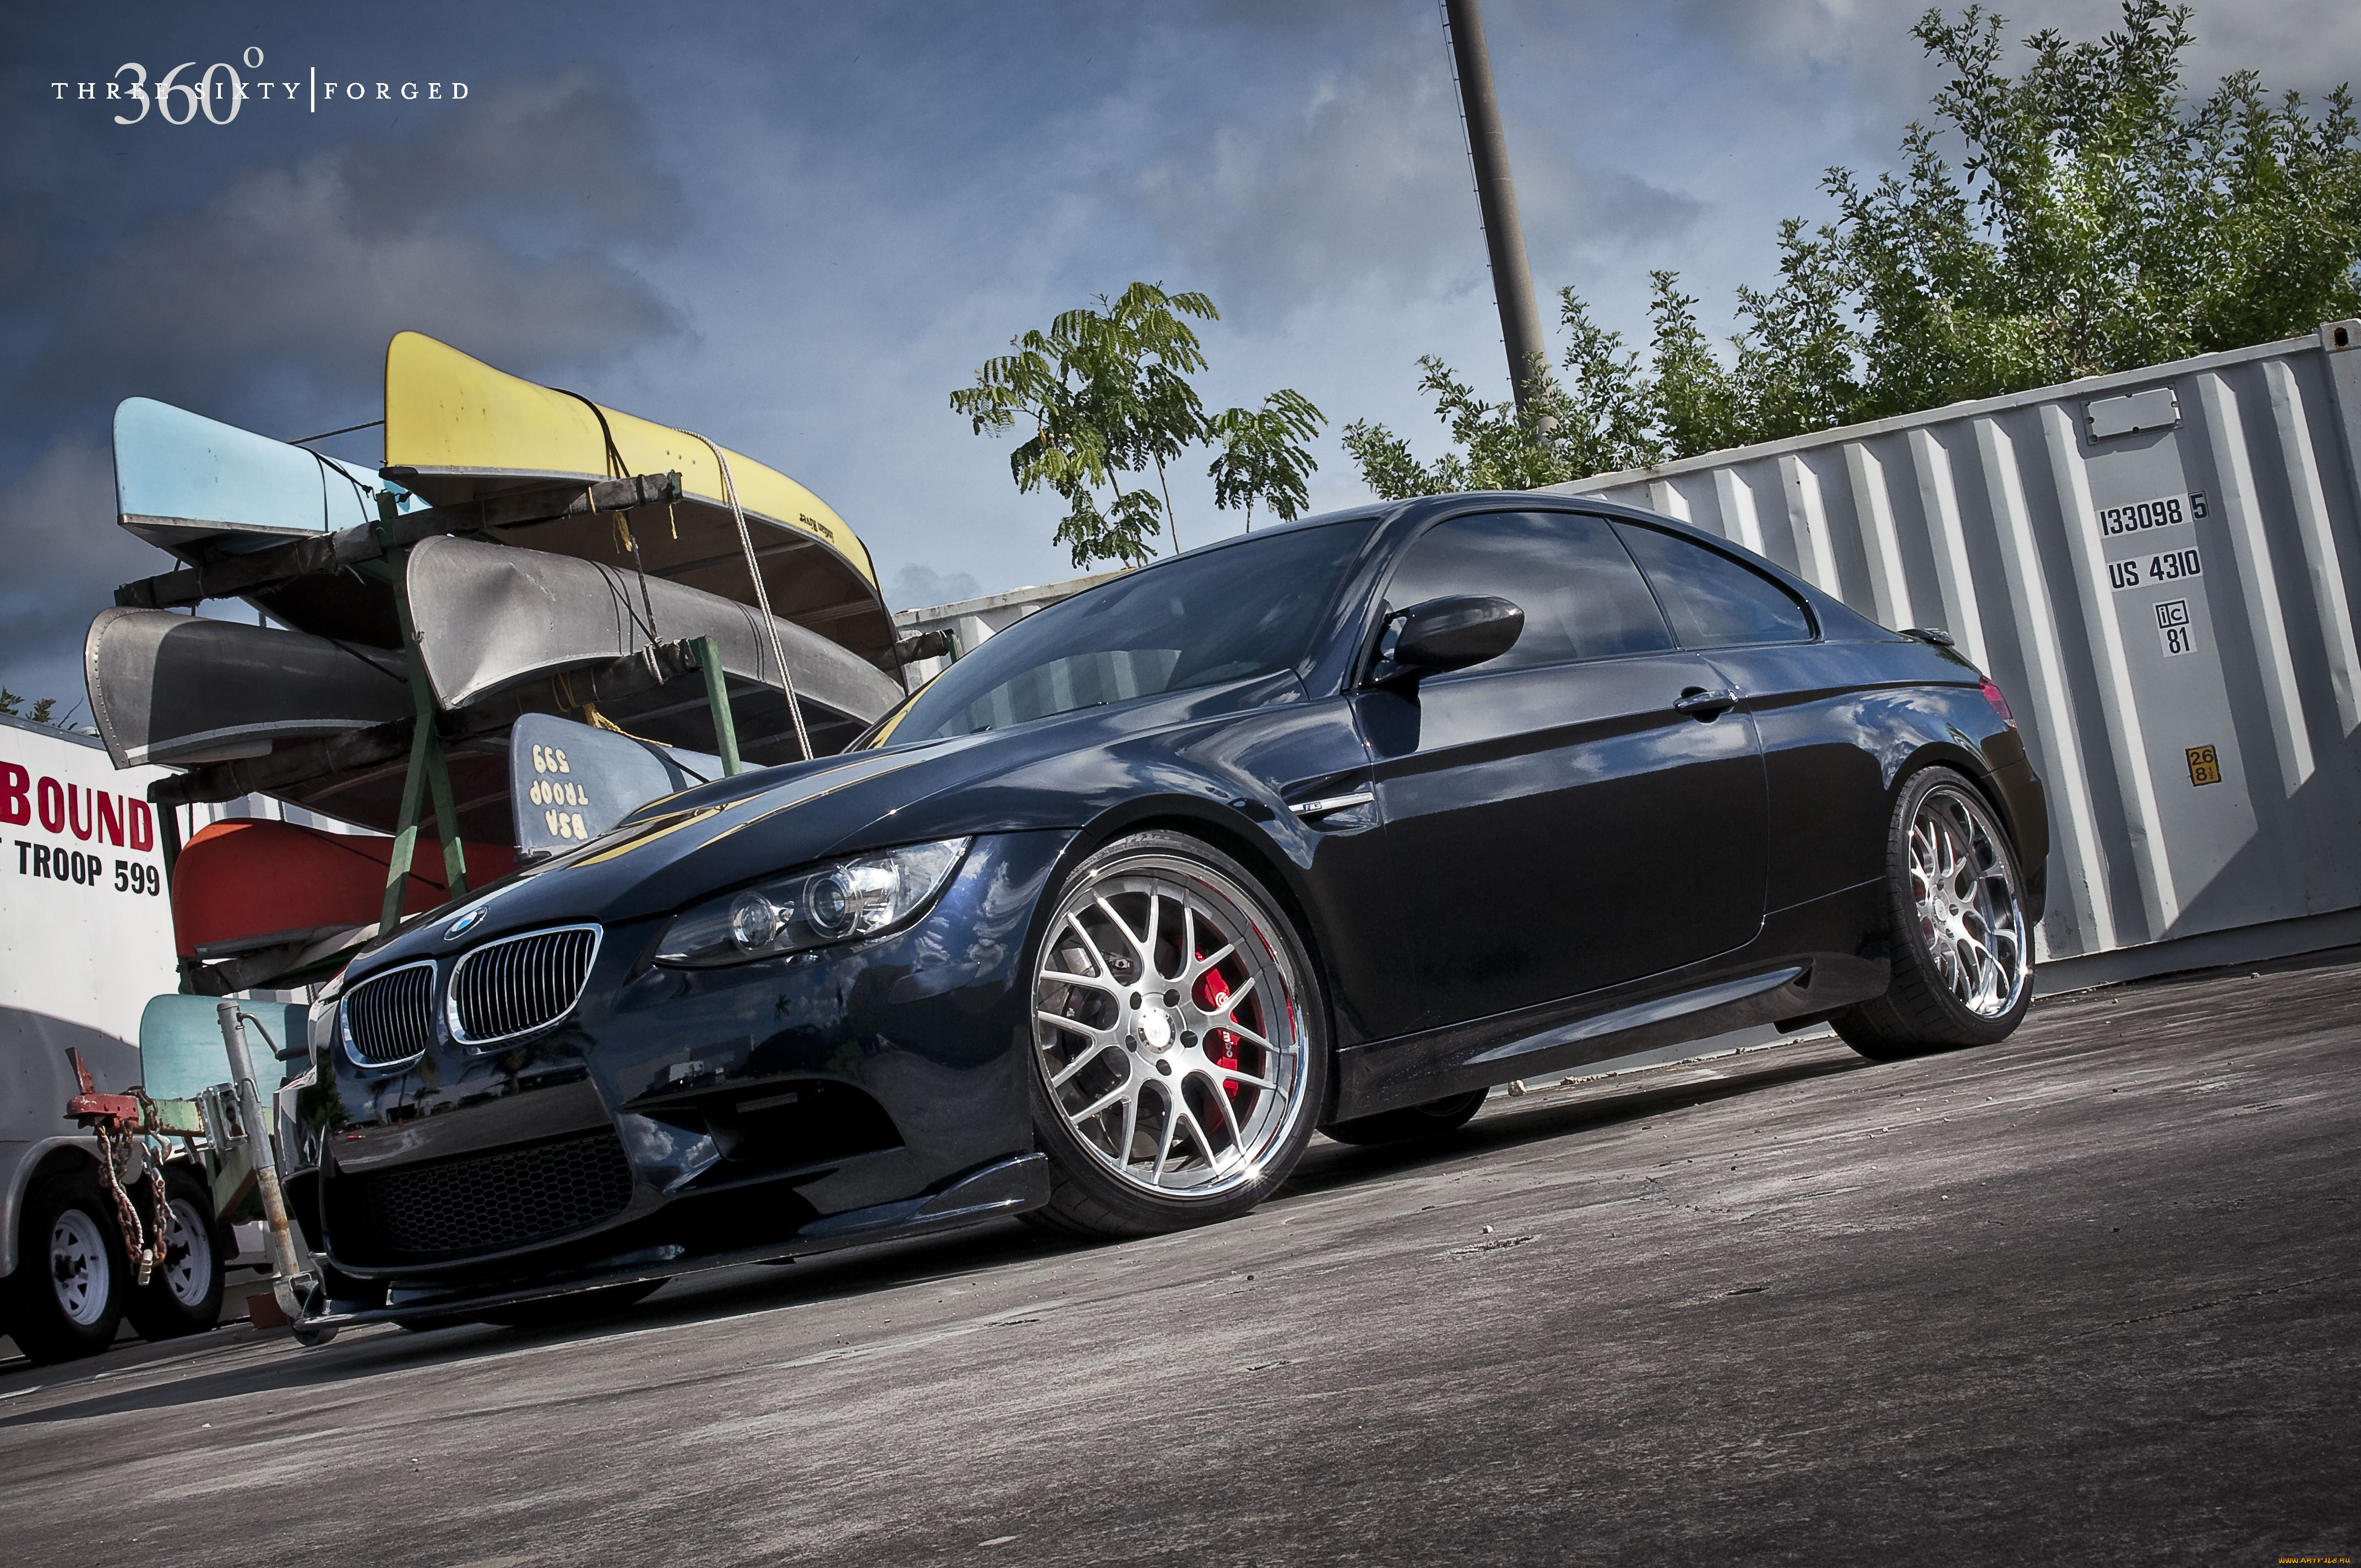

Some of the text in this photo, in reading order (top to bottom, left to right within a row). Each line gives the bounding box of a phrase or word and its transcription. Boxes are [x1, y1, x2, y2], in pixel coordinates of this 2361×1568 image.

[799, 513, 818, 532] River
[2100, 493, 2207, 536] 133098 5
[2109, 549, 2201, 589] US 4310
[2167, 627, 2190, 654] 81
[533, 744, 570, 774] 599
[0, 761, 154, 852] BOUND
[530, 780, 589, 806] TROOP
[545, 809, 589, 841] BSA
[14, 840, 160, 897] TROOP 599
